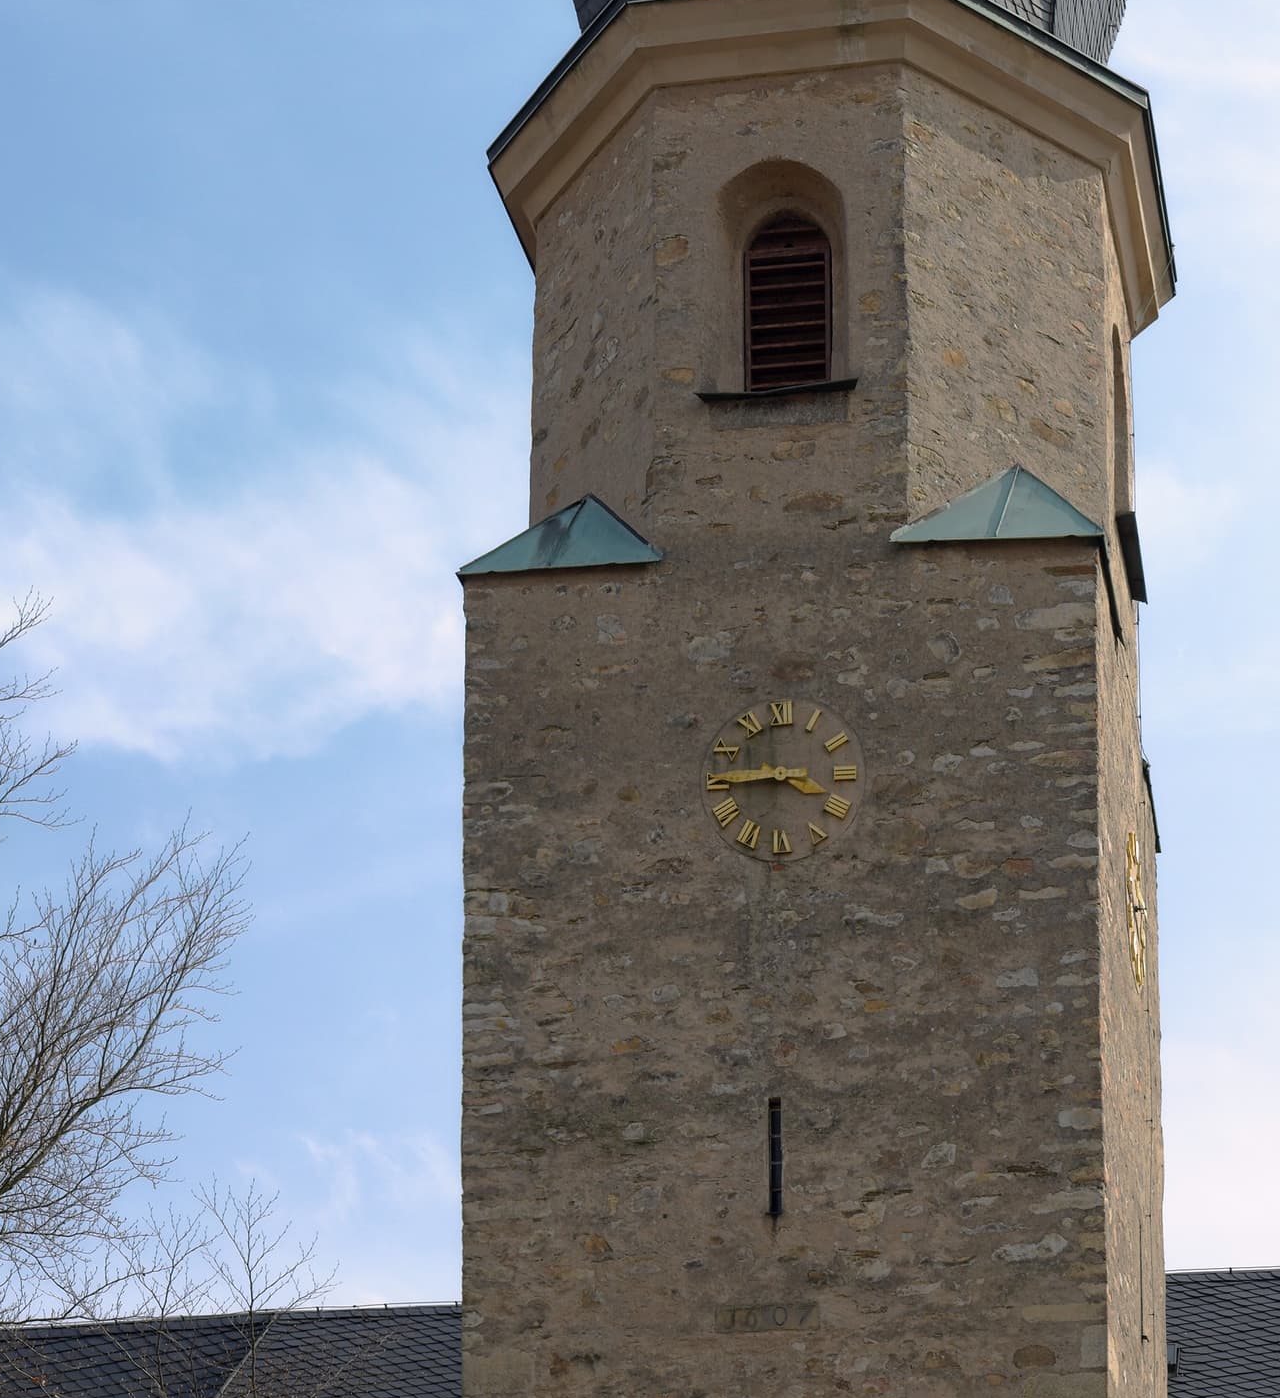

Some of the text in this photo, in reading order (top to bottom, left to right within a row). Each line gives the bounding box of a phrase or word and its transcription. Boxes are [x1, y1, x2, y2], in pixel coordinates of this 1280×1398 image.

[737, 711, 763, 739] XI
[769, 700, 793, 726] XII
[805, 709, 822, 732] I
[713, 737, 740, 762] X
[824, 731, 849, 753] II
[833, 765, 857, 781] III
[824, 793, 852, 819] IIII
[808, 822, 828, 846] V
